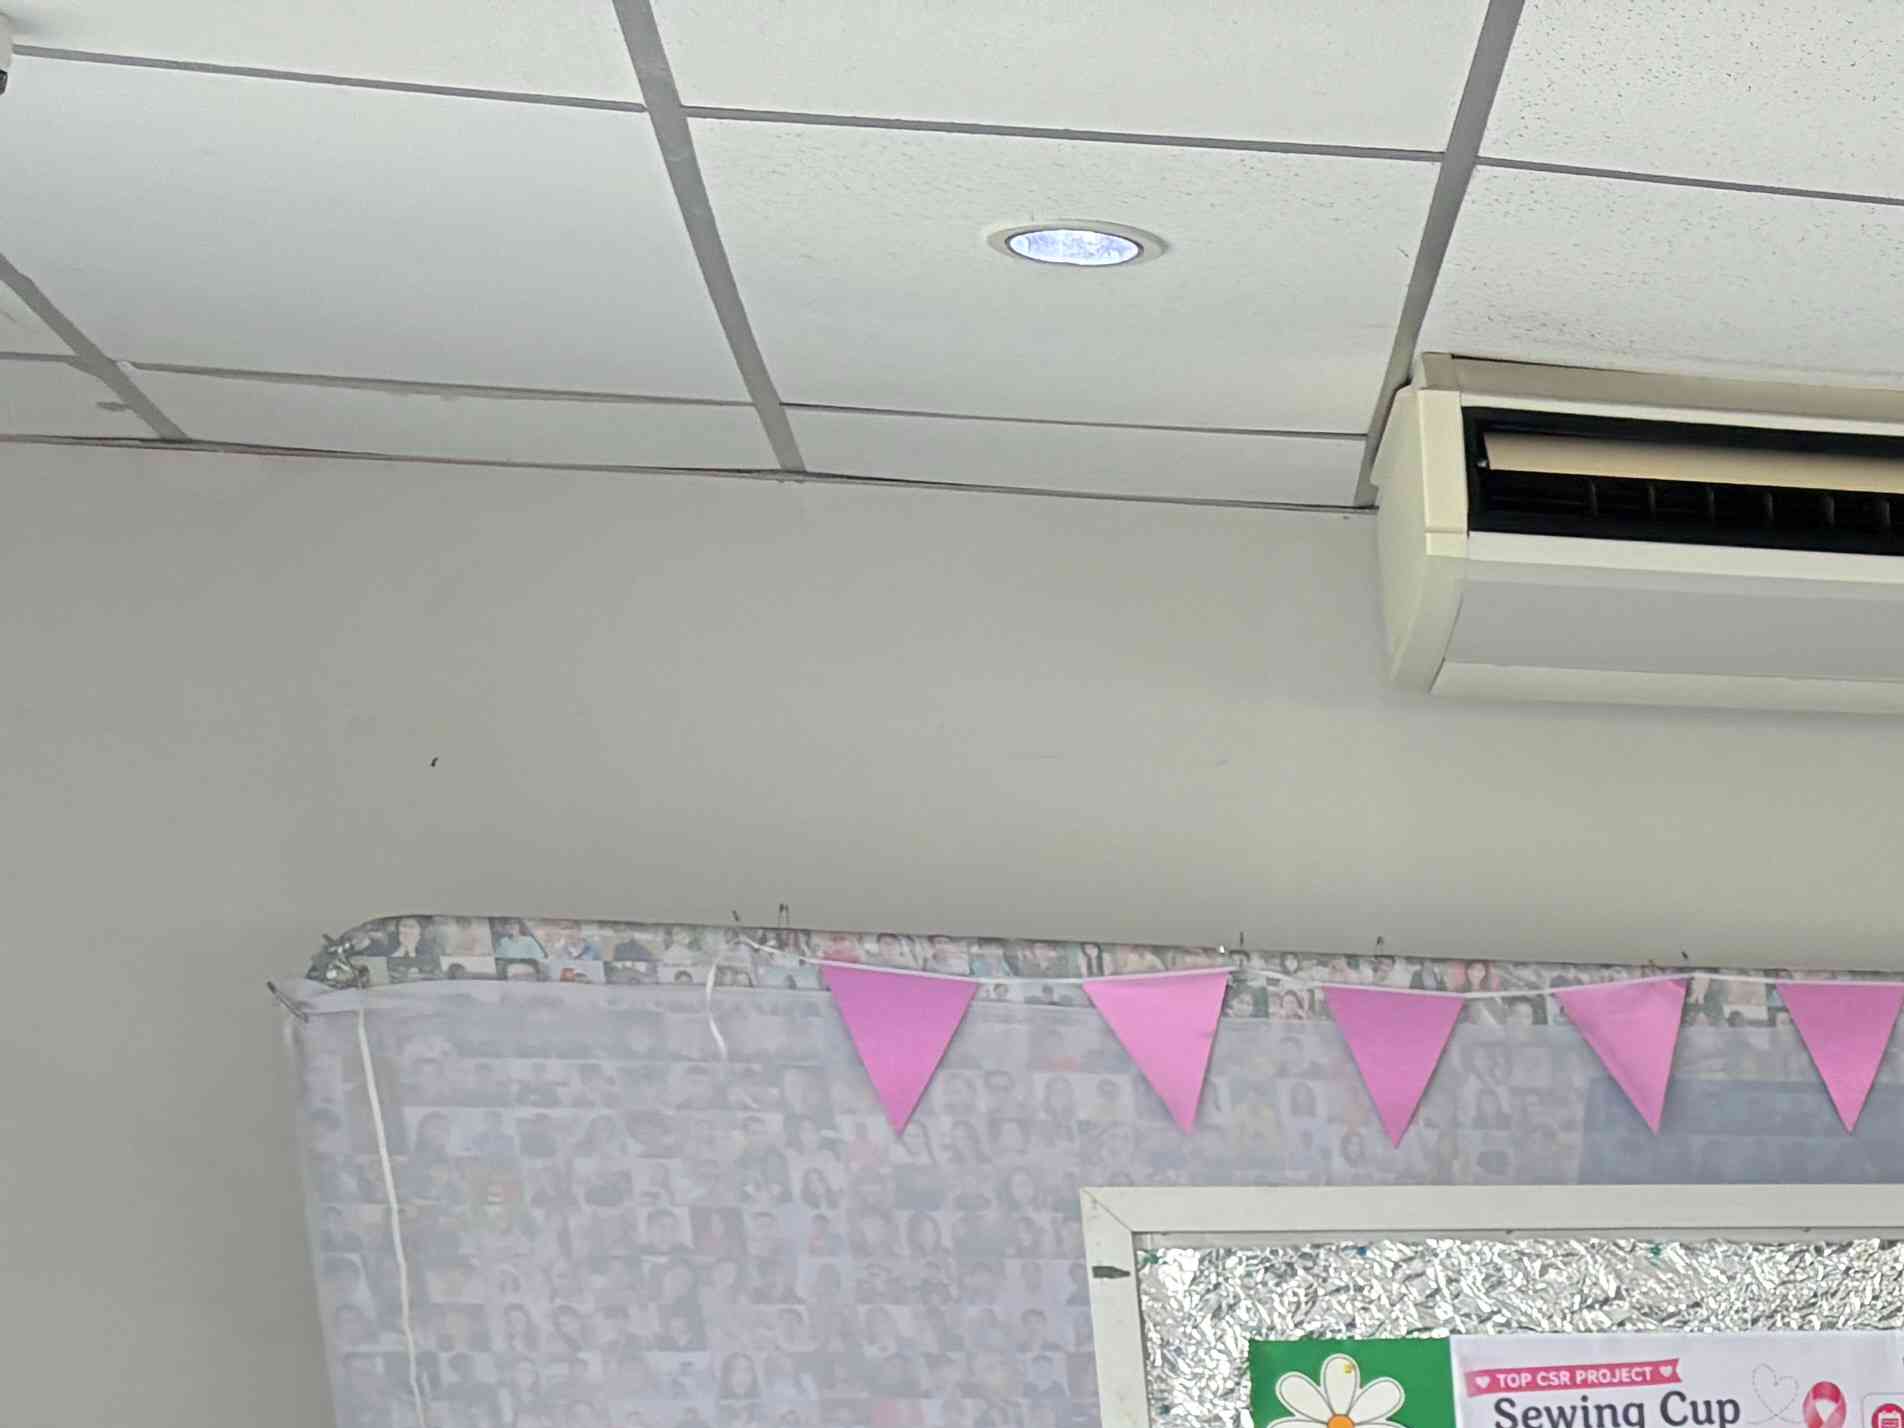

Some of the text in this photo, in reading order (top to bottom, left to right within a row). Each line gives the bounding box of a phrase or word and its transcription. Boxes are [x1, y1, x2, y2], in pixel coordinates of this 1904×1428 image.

[1496, 1367, 1653, 1389] TOP CSR PROJECT
